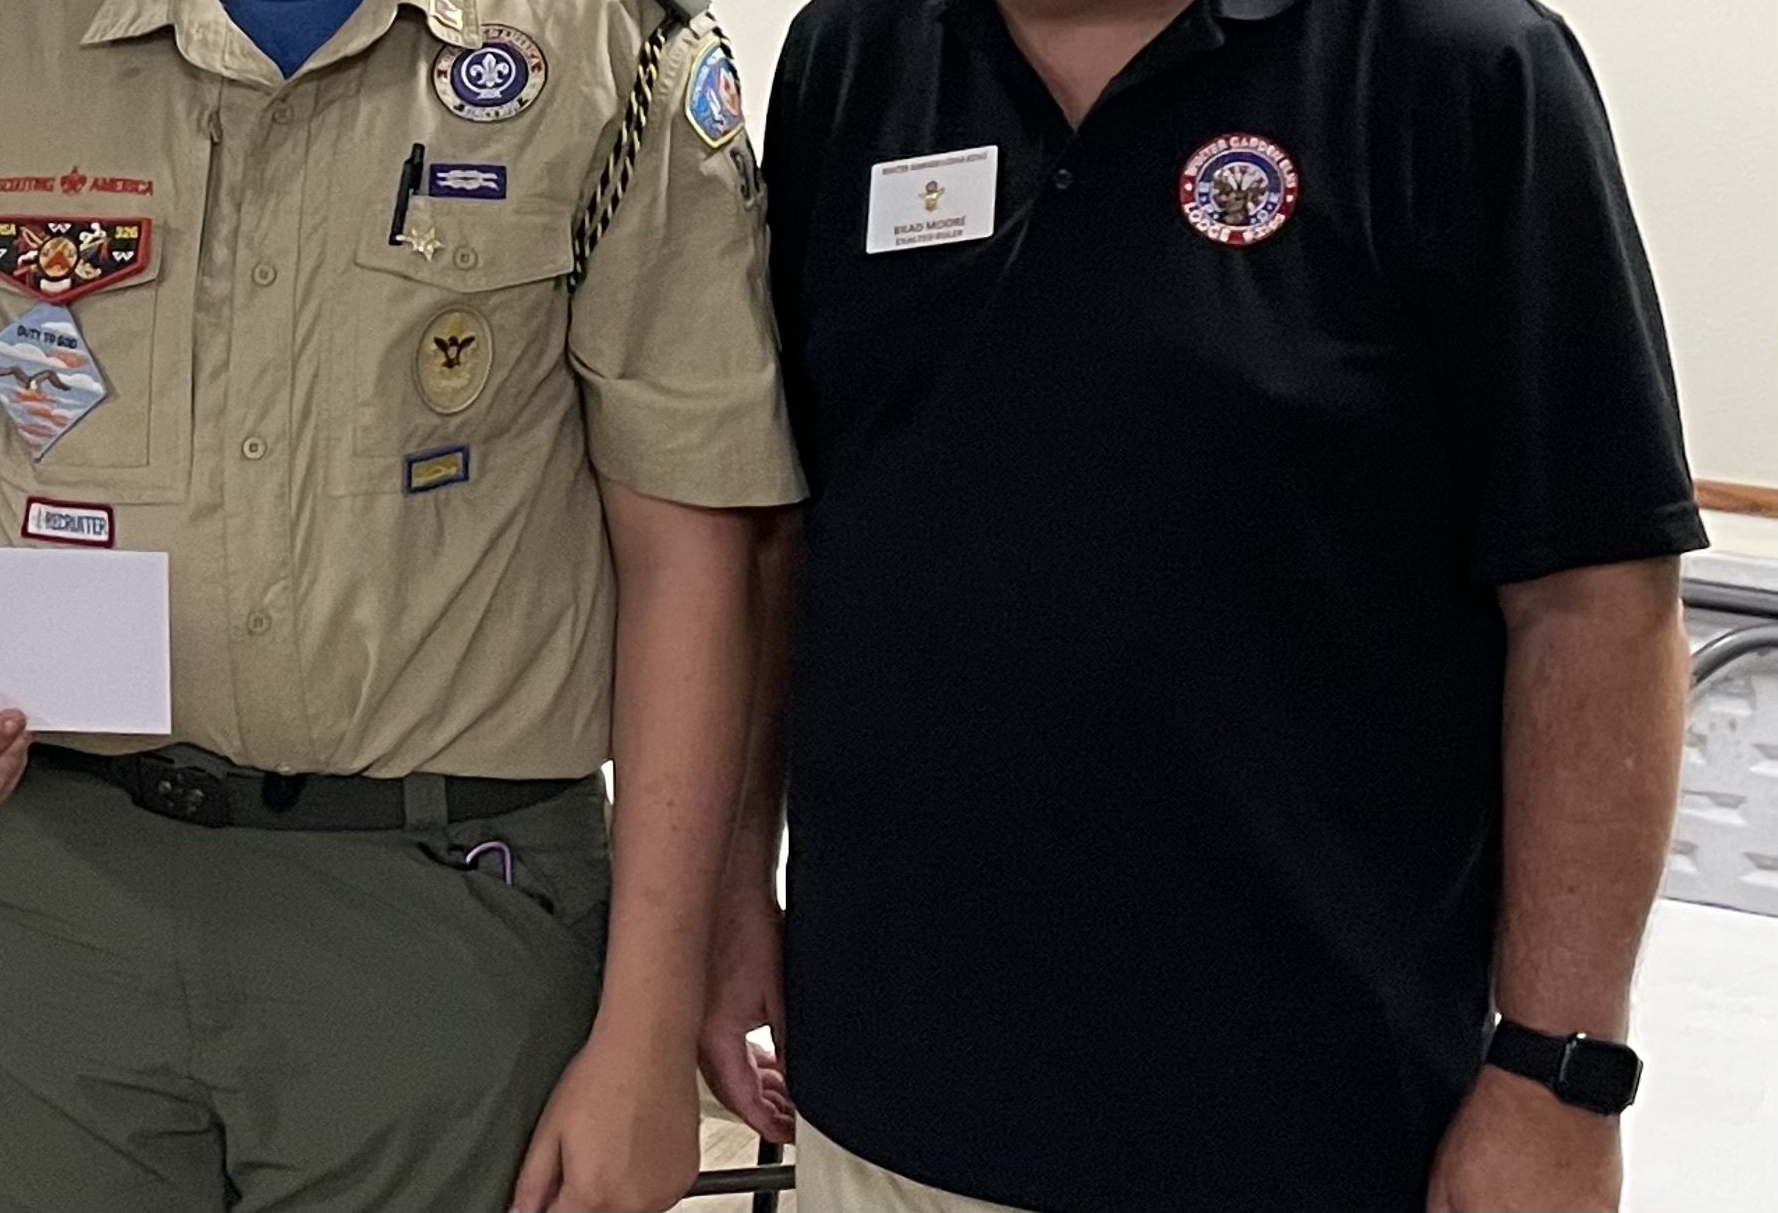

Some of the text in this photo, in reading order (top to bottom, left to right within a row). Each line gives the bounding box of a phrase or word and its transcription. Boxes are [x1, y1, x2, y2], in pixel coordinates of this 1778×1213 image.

[89, 176, 154, 196] AMERICA
[1183, 201, 1231, 243] LODGE
[17, 324, 41, 341] DUTY
[44, 331, 56, 344] TO
